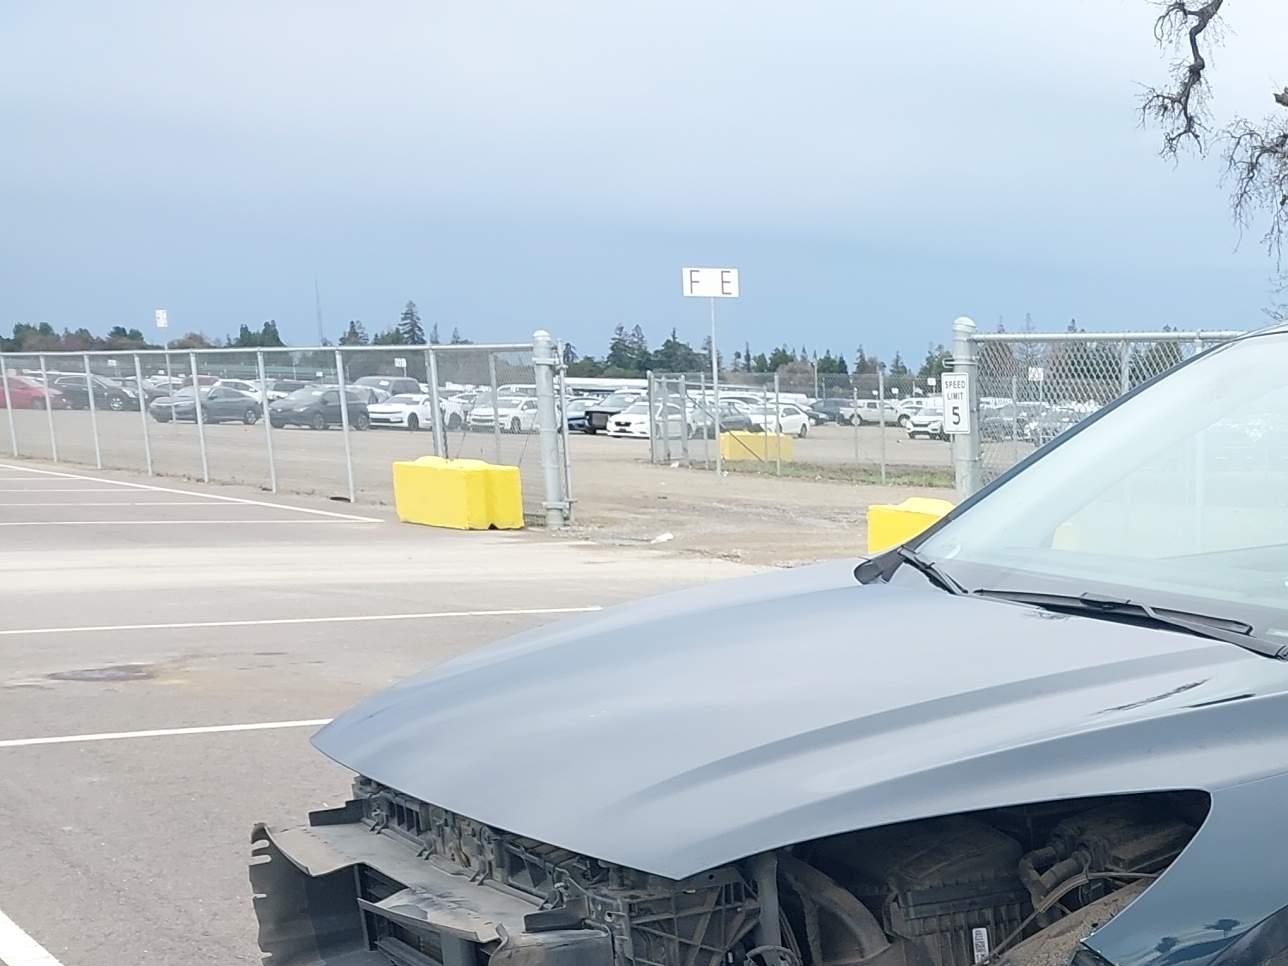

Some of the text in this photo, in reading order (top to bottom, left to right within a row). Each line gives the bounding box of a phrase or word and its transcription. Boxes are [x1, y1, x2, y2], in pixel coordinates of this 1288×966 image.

[690, 270, 732, 295] F E
[945, 380, 966, 389] SPEED
[947, 391, 964, 401] LIMIT
[952, 406, 961, 425] 5
